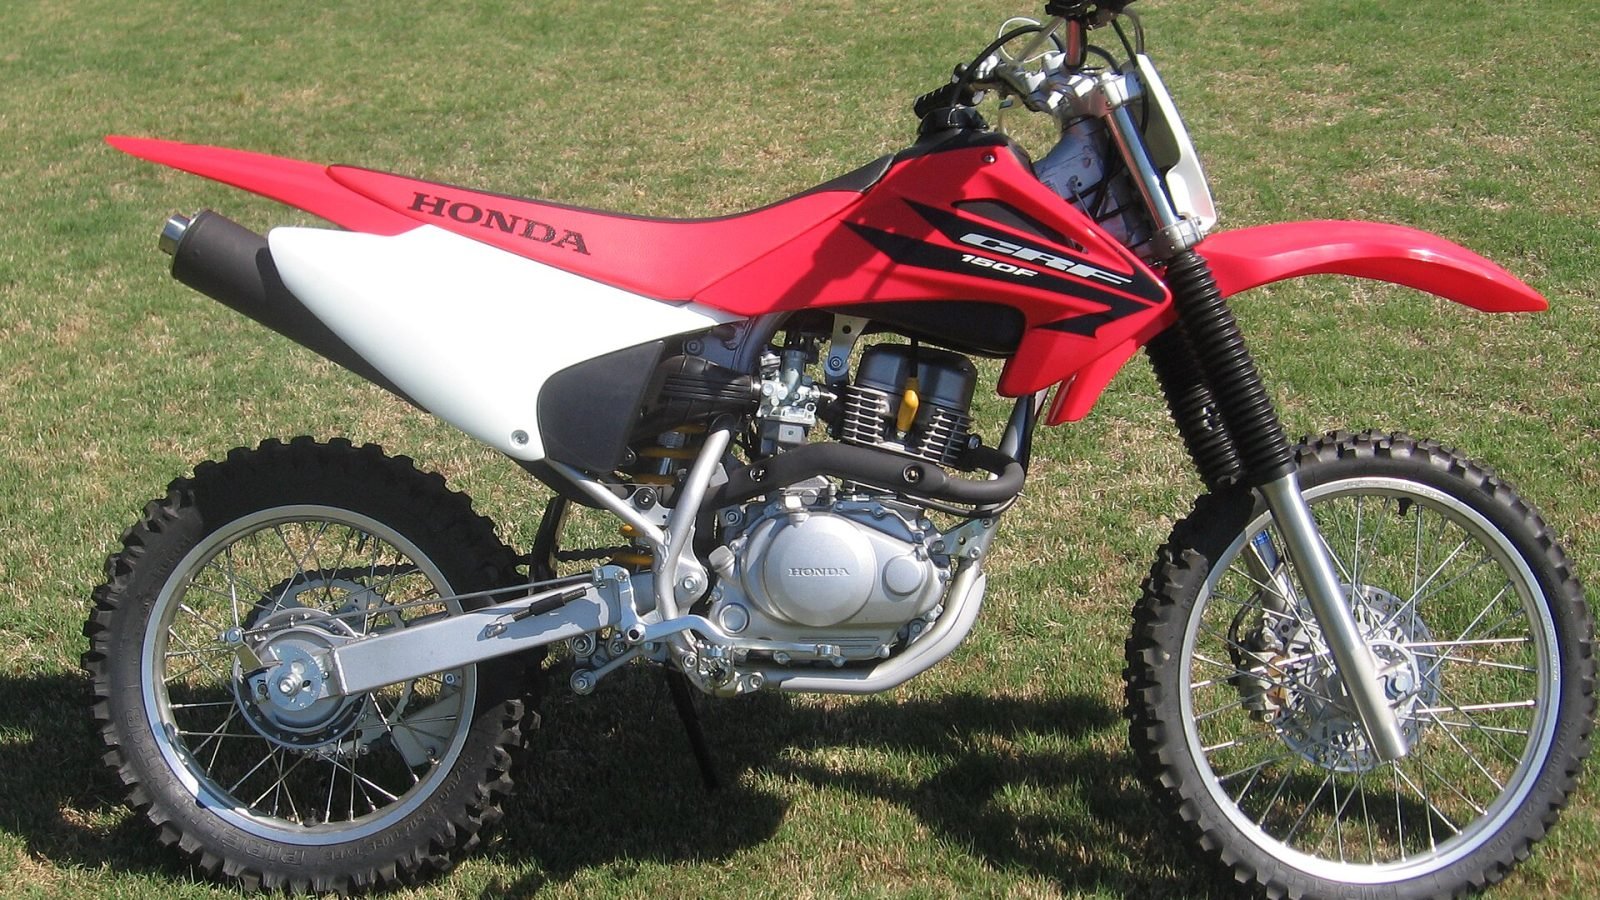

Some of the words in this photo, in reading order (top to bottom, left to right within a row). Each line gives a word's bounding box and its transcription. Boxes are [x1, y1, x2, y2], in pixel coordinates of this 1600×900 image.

[407, 191, 592, 256] HONDA
[959, 233, 1133, 285] CRF
[960, 254, 1039, 278] 150F
[788, 567, 851, 577] HONDA
